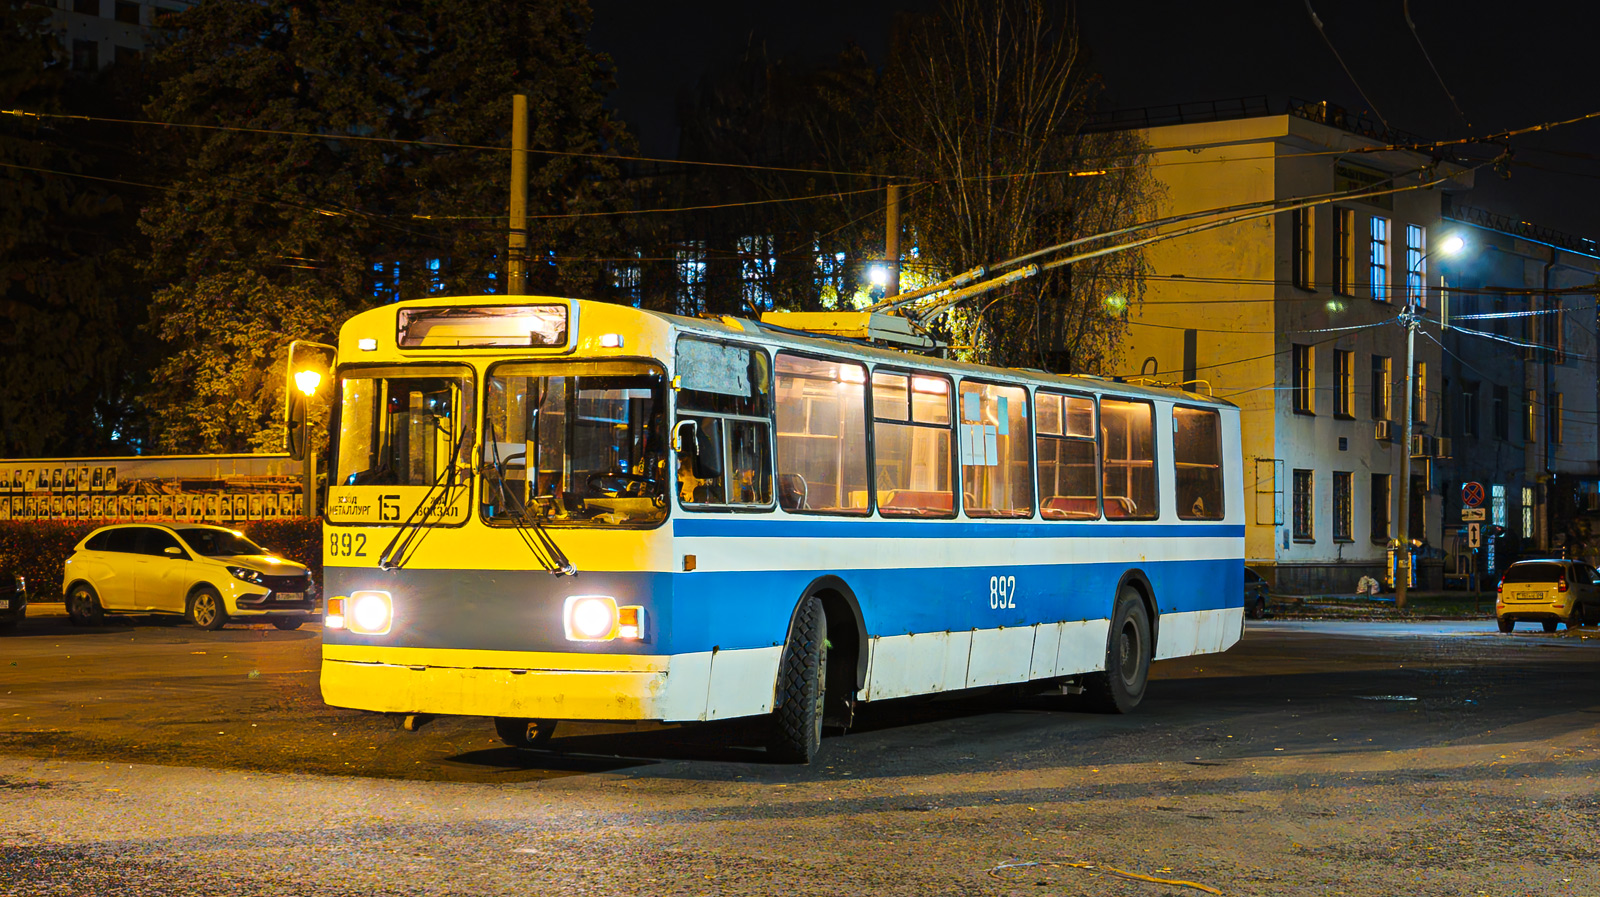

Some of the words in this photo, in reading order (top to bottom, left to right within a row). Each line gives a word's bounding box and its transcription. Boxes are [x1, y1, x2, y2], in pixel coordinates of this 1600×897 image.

[329, 505, 371, 515] МЕТАЛЛУРГ
[377, 494, 400, 520] 15
[416, 506, 458, 516] ВОКЗАЛ
[329, 533, 367, 557] 892
[989, 575, 1016, 609] 892
